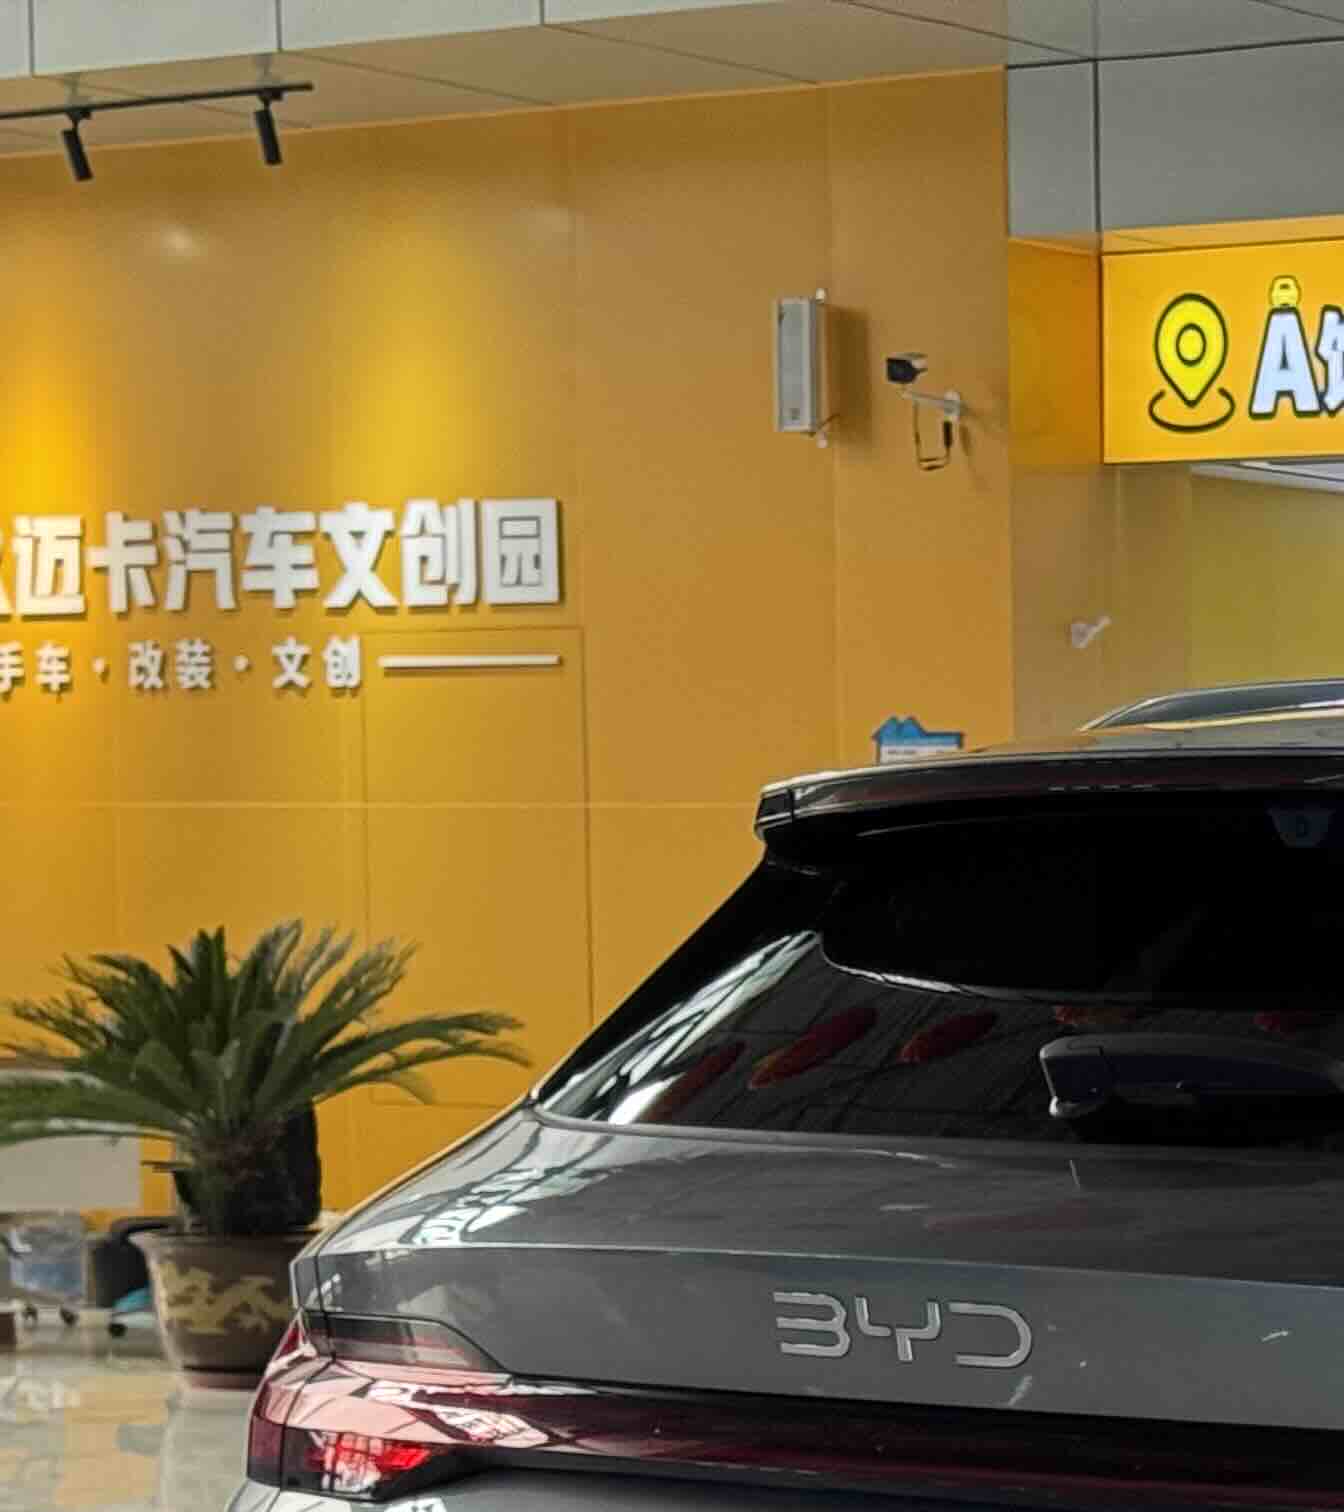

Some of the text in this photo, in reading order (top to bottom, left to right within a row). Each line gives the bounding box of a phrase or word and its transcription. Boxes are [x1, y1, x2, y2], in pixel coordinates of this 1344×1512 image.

[0, 498, 563, 617] 迈卡汽车文创园
[773, 1291, 1032, 1368] BYD
